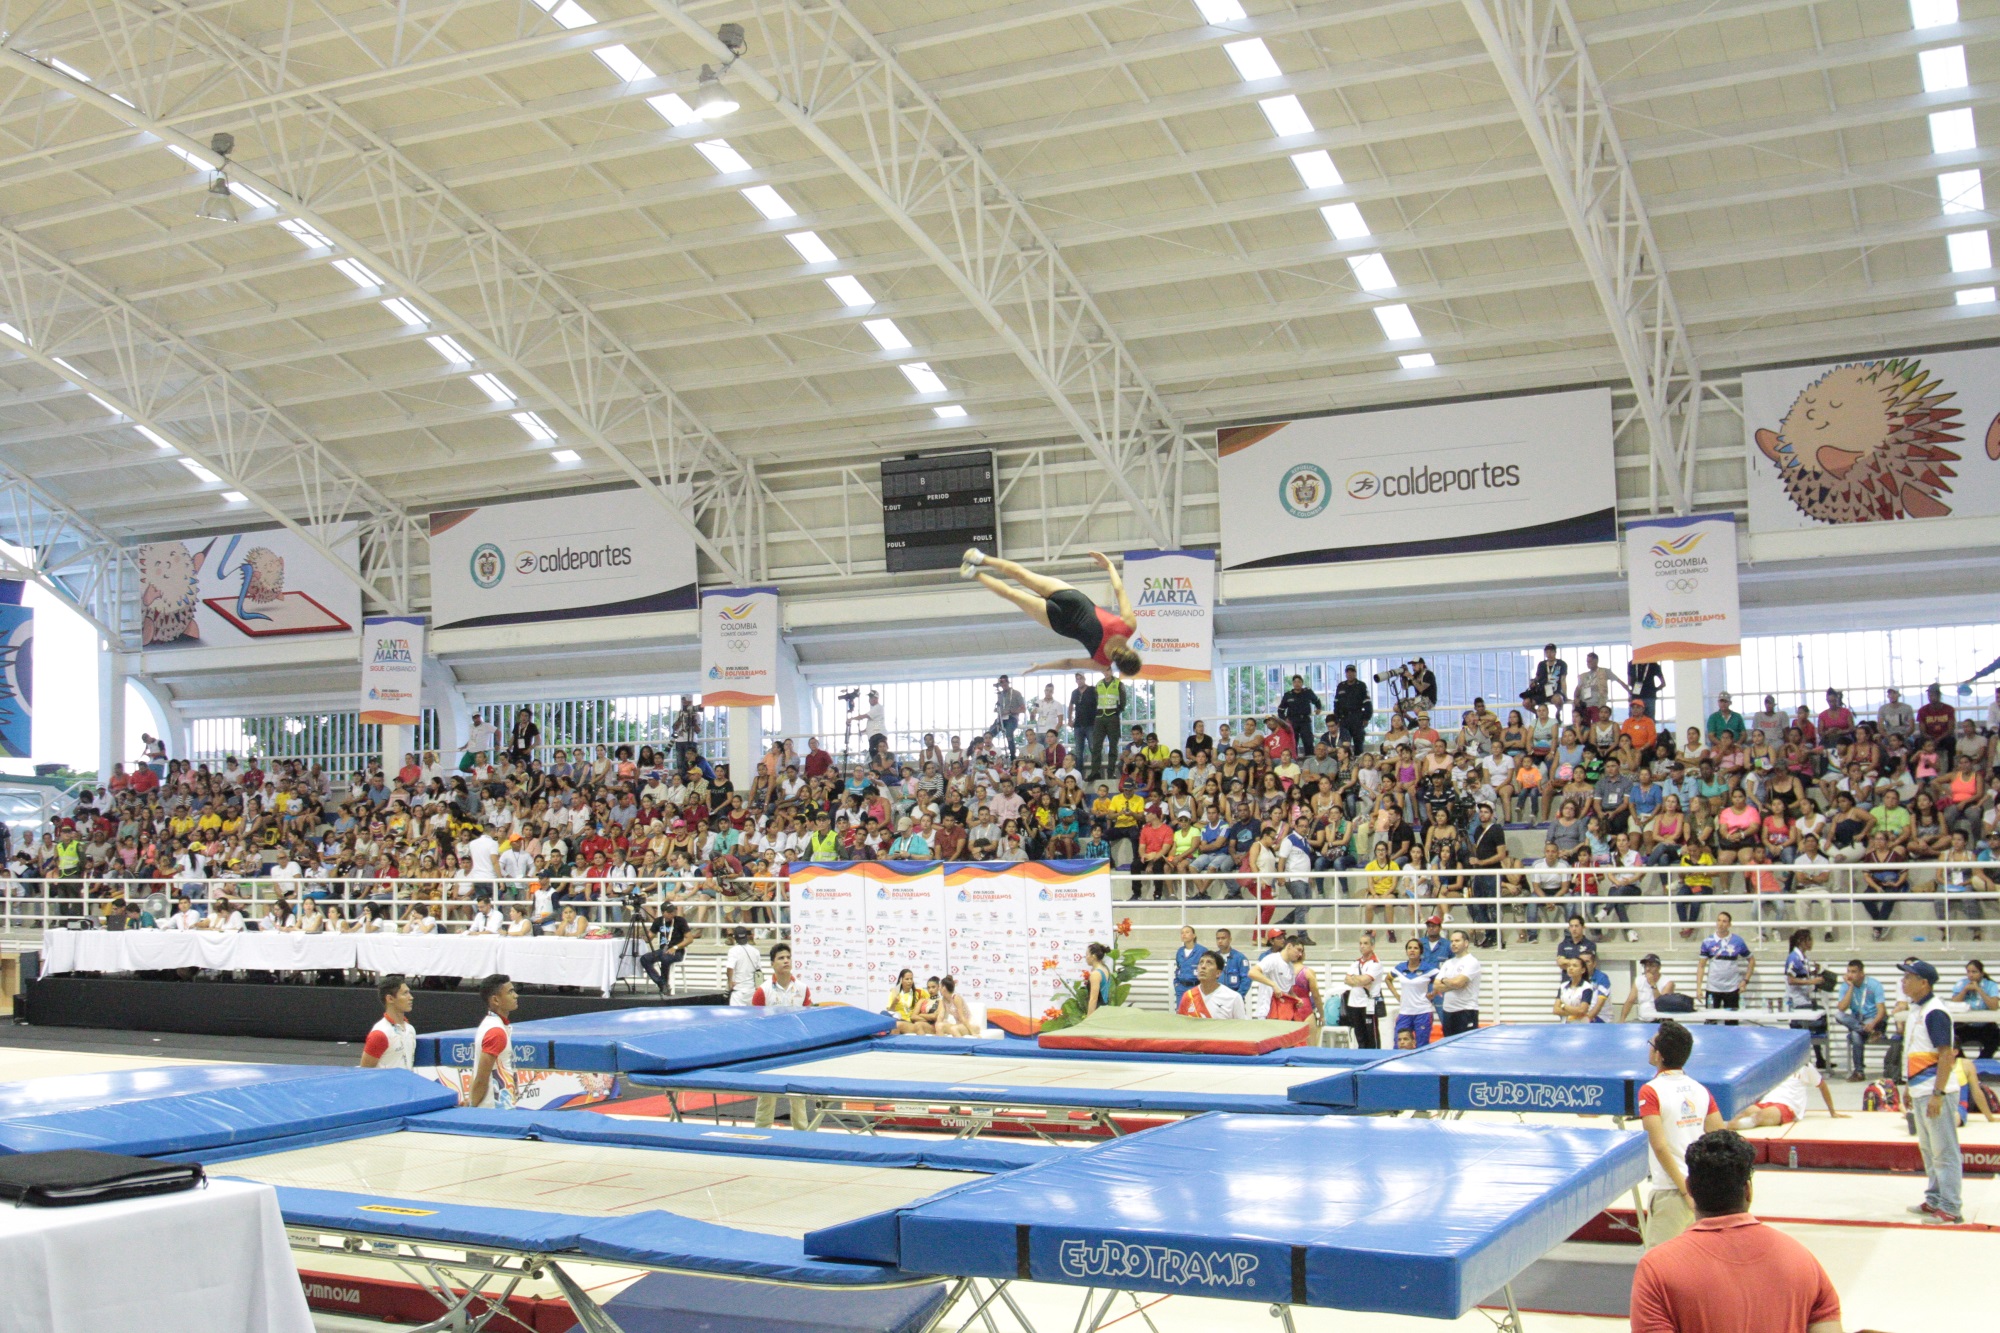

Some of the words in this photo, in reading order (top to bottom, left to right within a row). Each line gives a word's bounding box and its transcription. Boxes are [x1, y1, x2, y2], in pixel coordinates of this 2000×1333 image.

[1383, 462, 1520, 497] coldeportes
[927, 493, 949, 501] PERIOD
[973, 496, 992, 504] T.OUT
[539, 545, 632, 573] coldeportes
[1654, 557, 1708, 569] COLOMBIA
[1143, 577, 1193, 590] SANTA
[1138, 590, 1197, 605] MARTA
[1133, 609, 1156, 617] SIGUE
[1158, 609, 1205, 617] CAMBIANDO
[1665, 613, 1726, 624] BOLIVARIANOS
[377, 639, 410, 650] SANTA
[373, 650, 412, 662] MARTA
[526, 1088, 540, 1098] 2017
[1469, 1081, 1603, 1107] EUROTRAMP
[1059, 1239, 1259, 1286] EUROTRAMP
[302, 1283, 360, 1303] YMNOVA
